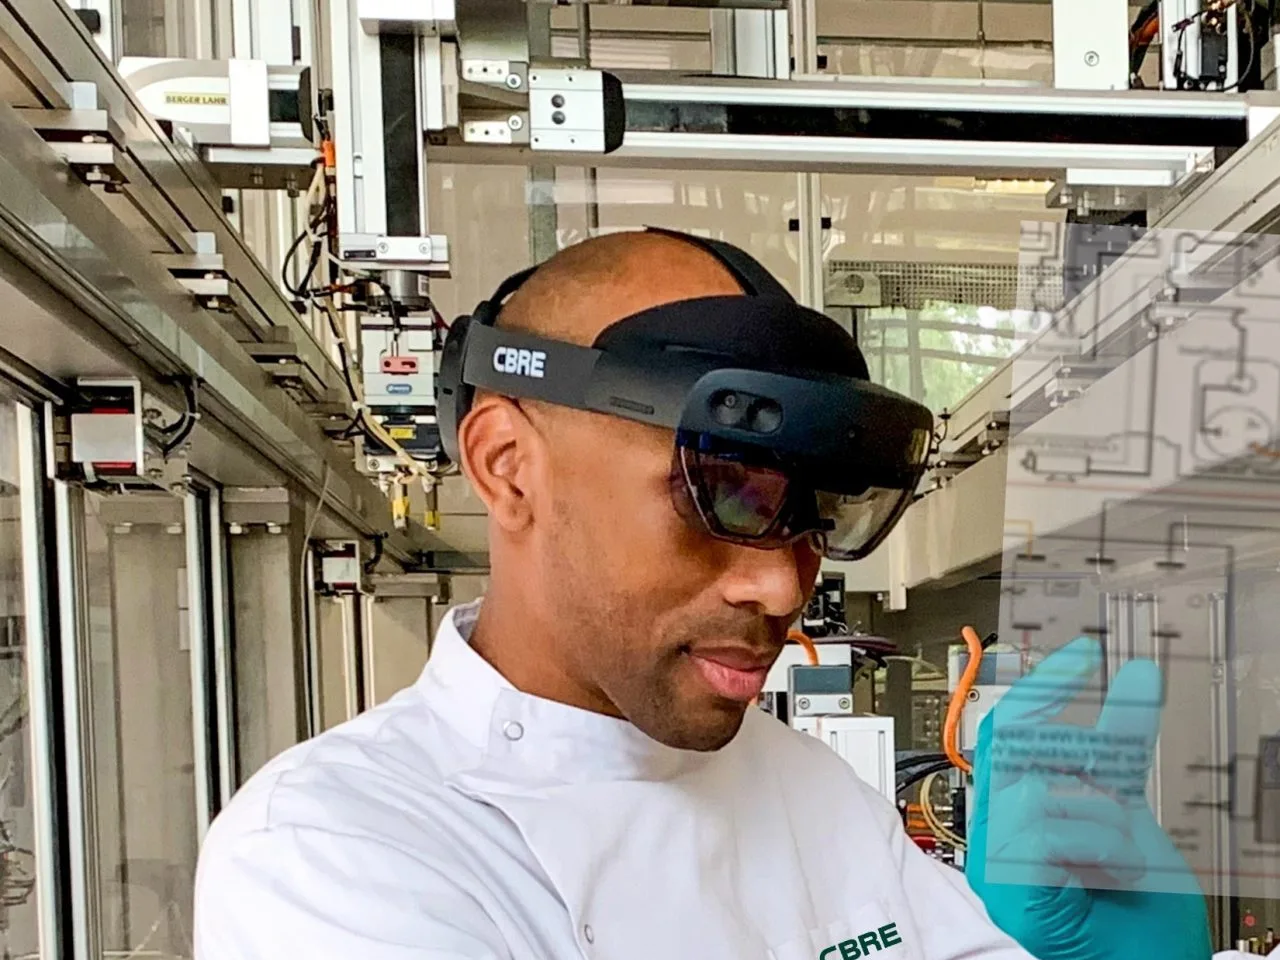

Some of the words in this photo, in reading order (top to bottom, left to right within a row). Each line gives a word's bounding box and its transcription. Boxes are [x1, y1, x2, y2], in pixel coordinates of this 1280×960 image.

[166, 95, 200, 104] BERGER
[202, 97, 227, 105] LAHR
[493, 346, 546, 378] CBRE
